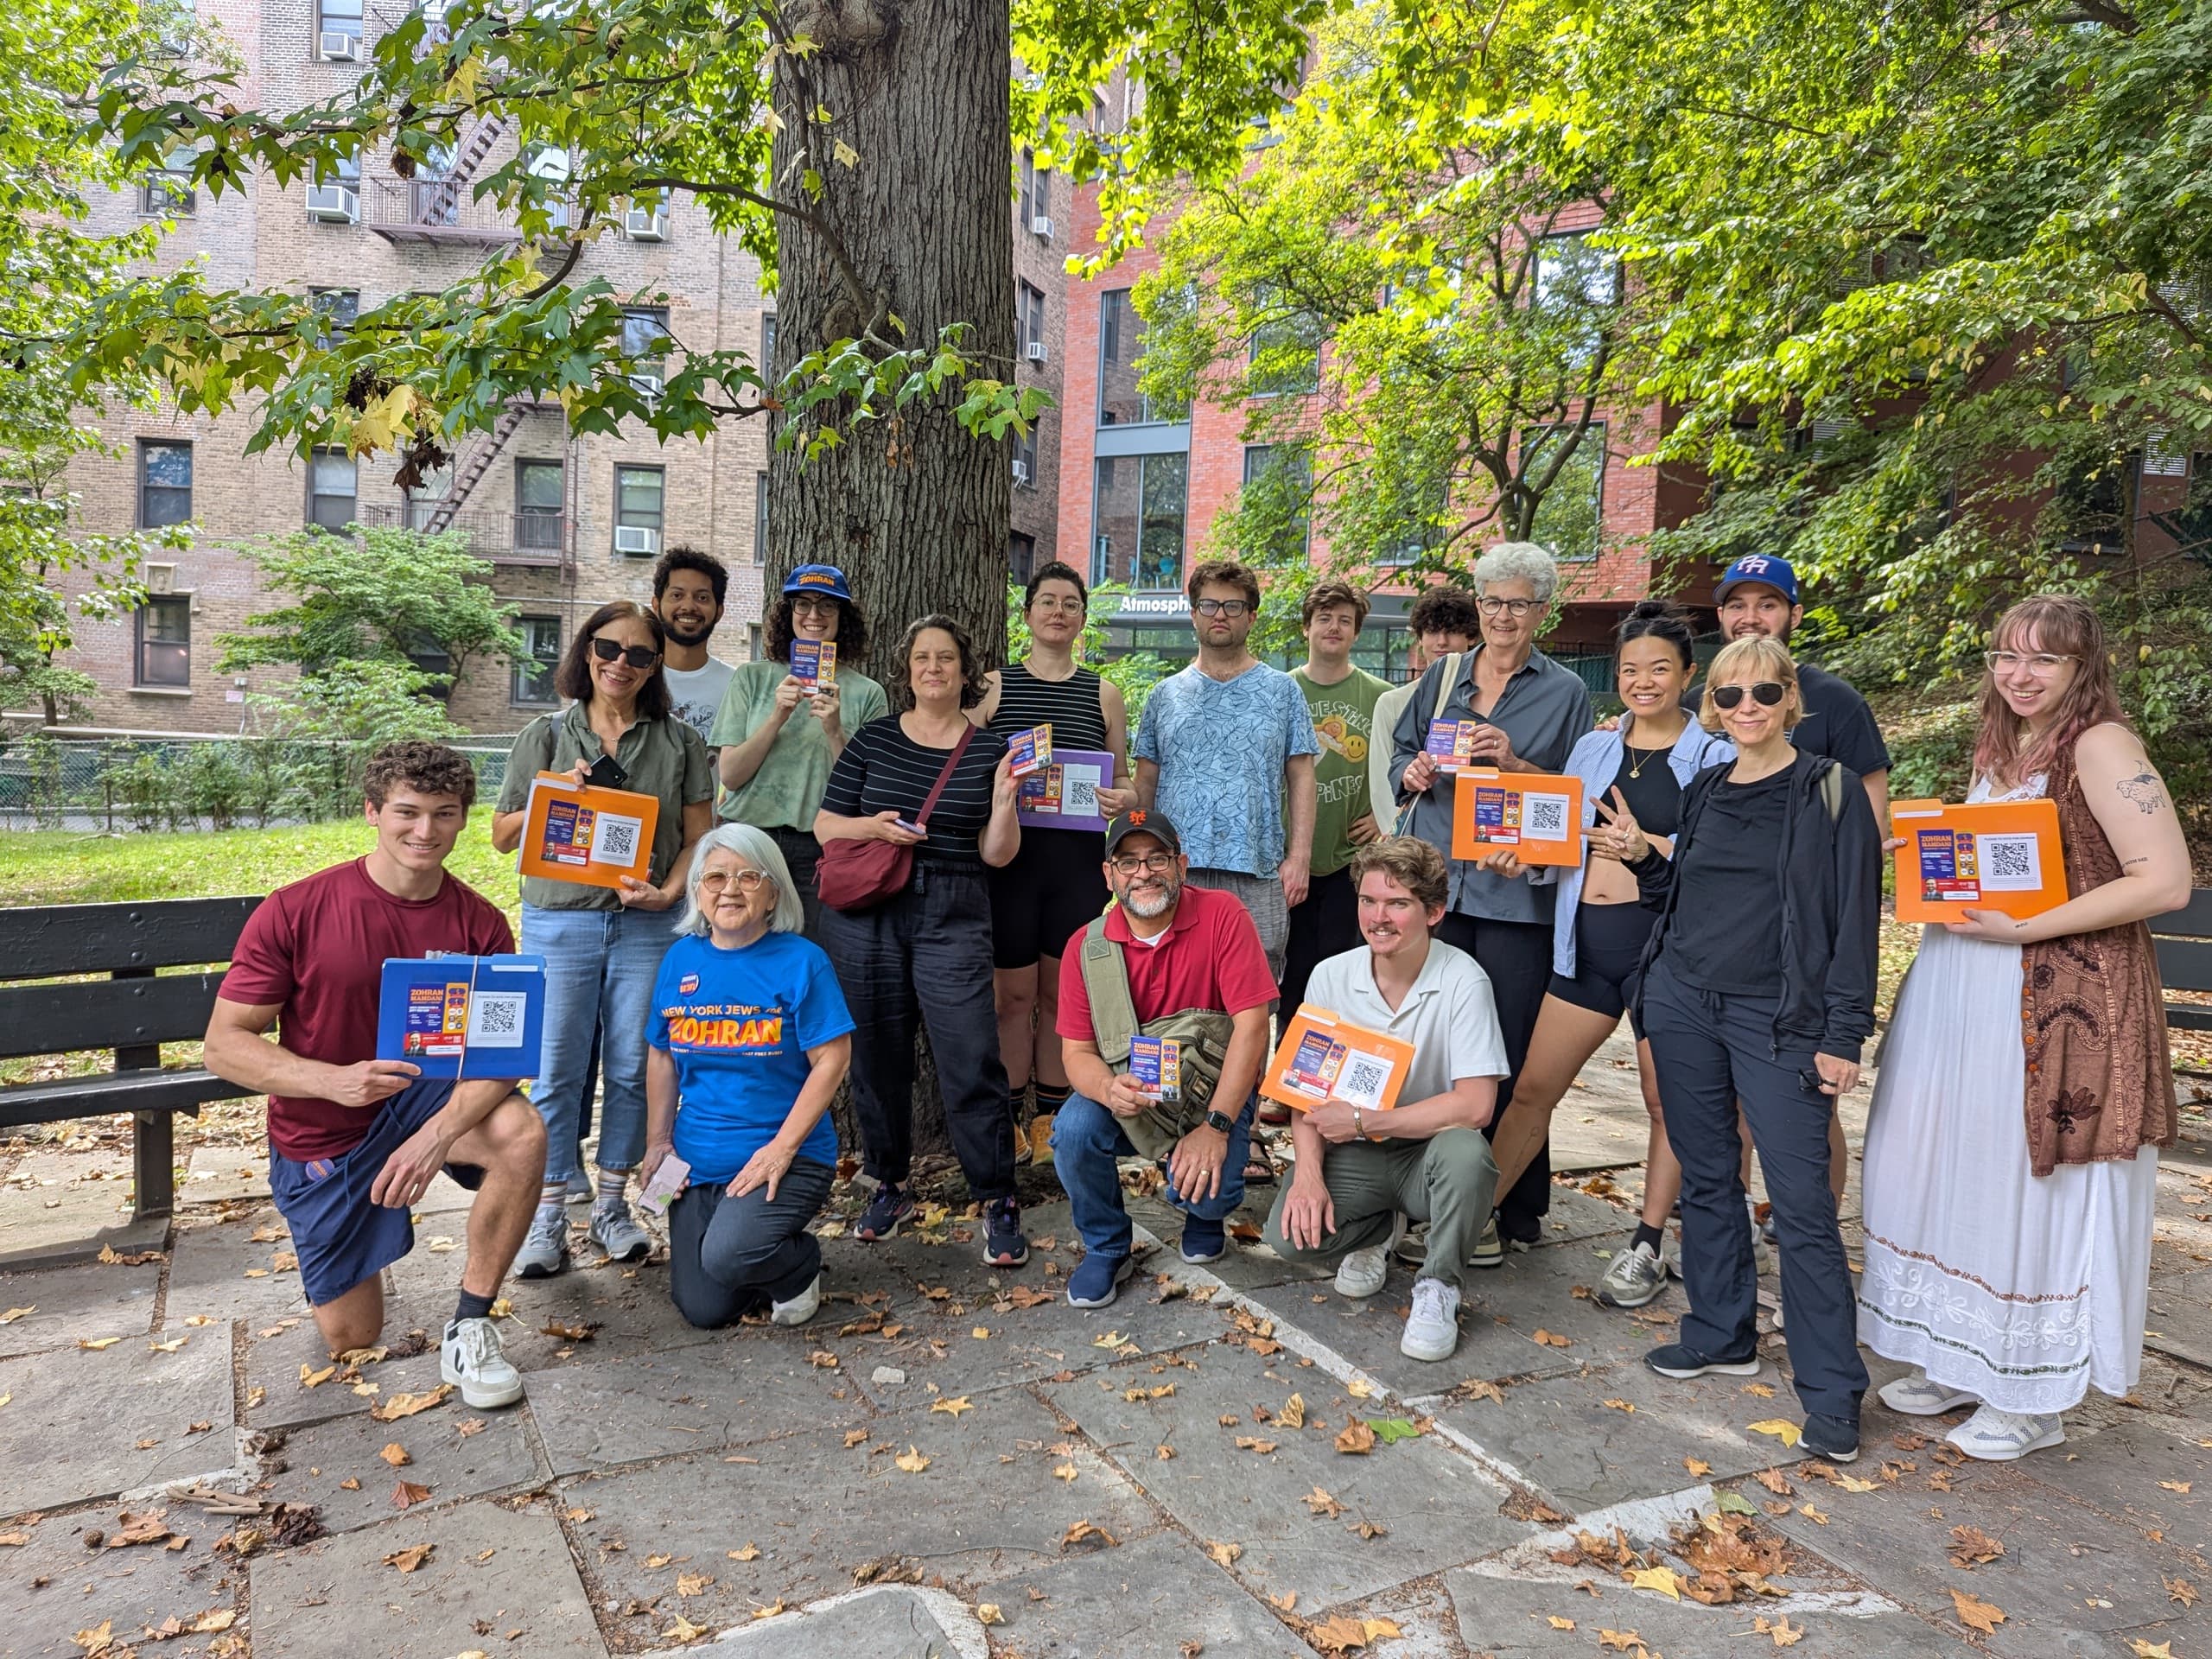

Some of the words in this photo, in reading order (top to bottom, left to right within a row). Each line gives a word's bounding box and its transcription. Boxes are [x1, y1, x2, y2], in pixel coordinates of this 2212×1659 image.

[799, 575, 836, 587] ZOHRAN
[1120, 595, 1191, 615] Atmosph
[1316, 775, 1364, 803] PiNES
[662, 1006, 687, 1018] NEW
[690, 1005, 723, 1016] YORK
[725, 1005, 760, 1016] JEWS
[669, 1016, 783, 1048] ZOHRAN
